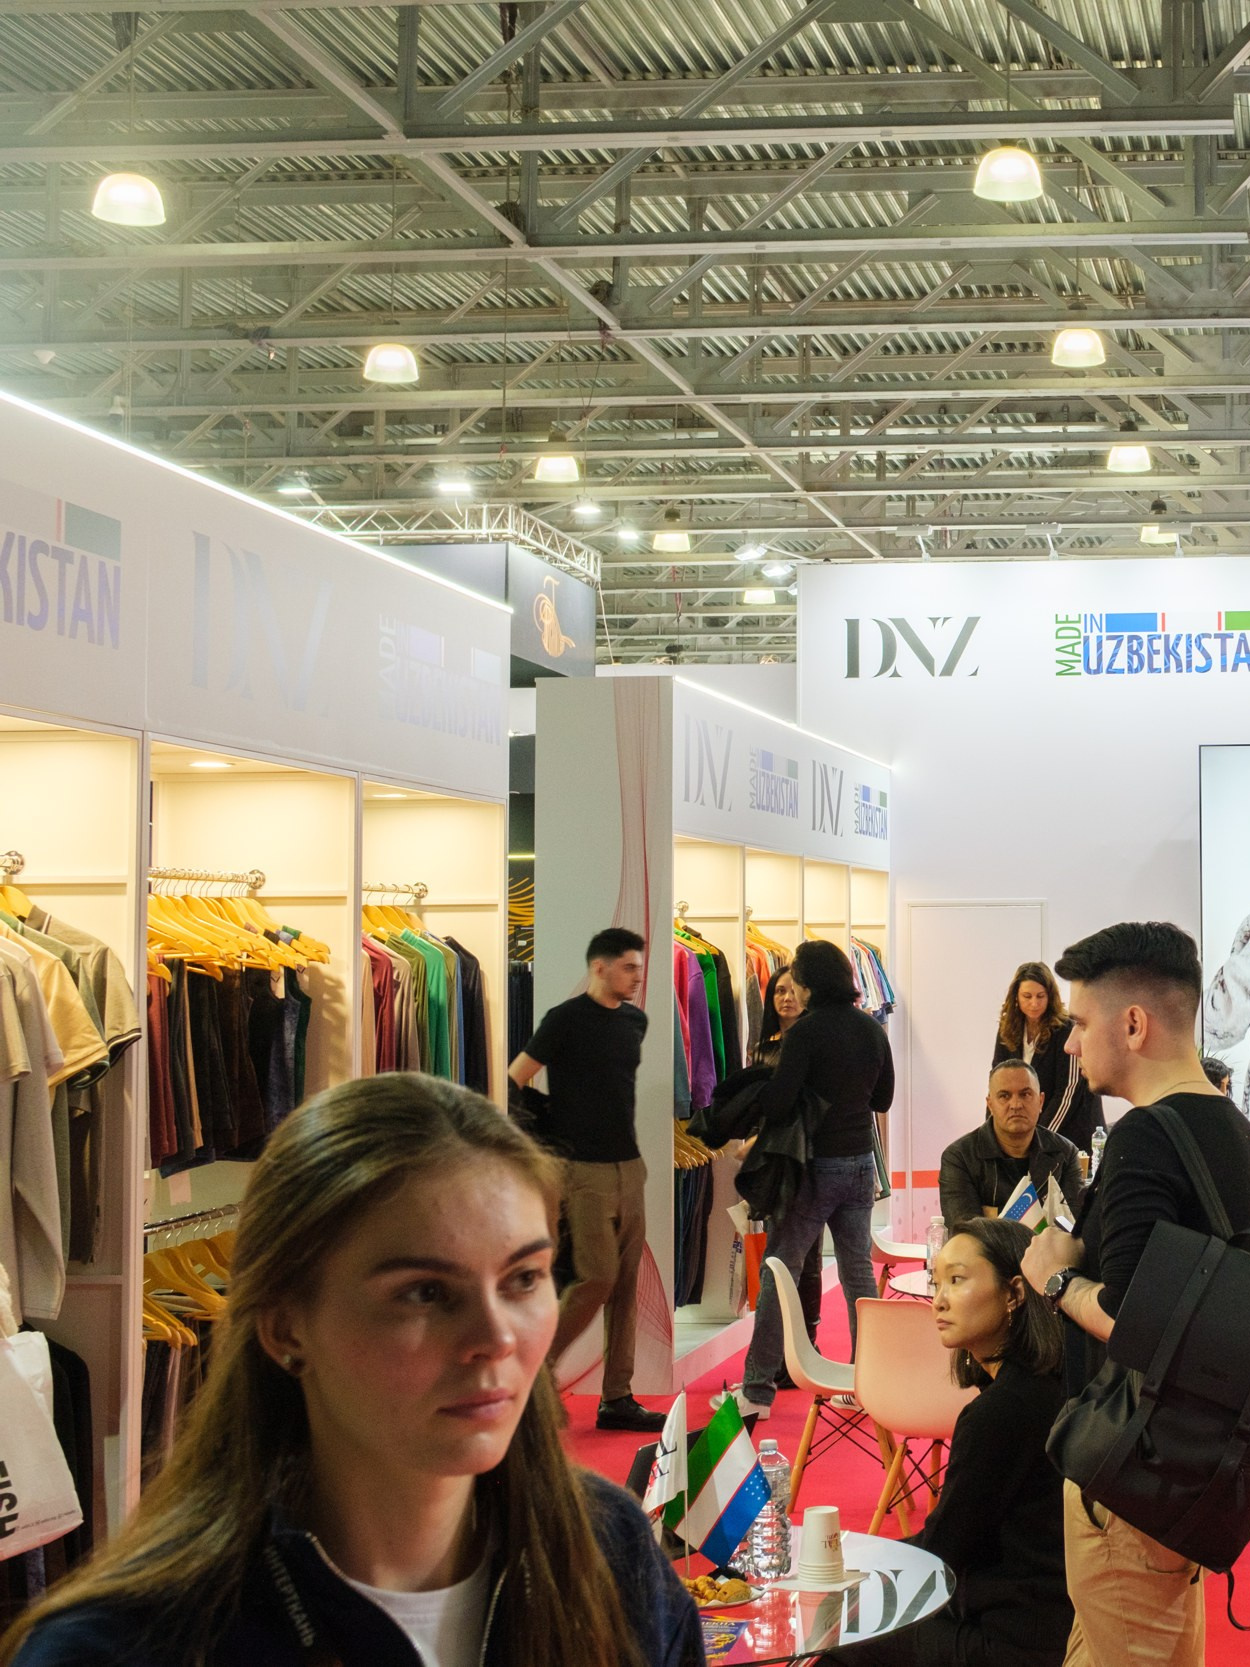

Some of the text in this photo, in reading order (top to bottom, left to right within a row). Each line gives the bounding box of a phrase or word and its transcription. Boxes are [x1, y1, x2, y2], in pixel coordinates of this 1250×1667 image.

[844, 616, 981, 678] DNZ
[1055, 613, 1081, 676] MADE
[1084, 613, 1103, 633] IN
[684, 713, 734, 812] DNZ
[756, 768, 799, 819] UZBEKISTAN
[812, 759, 844, 837] DNZ
